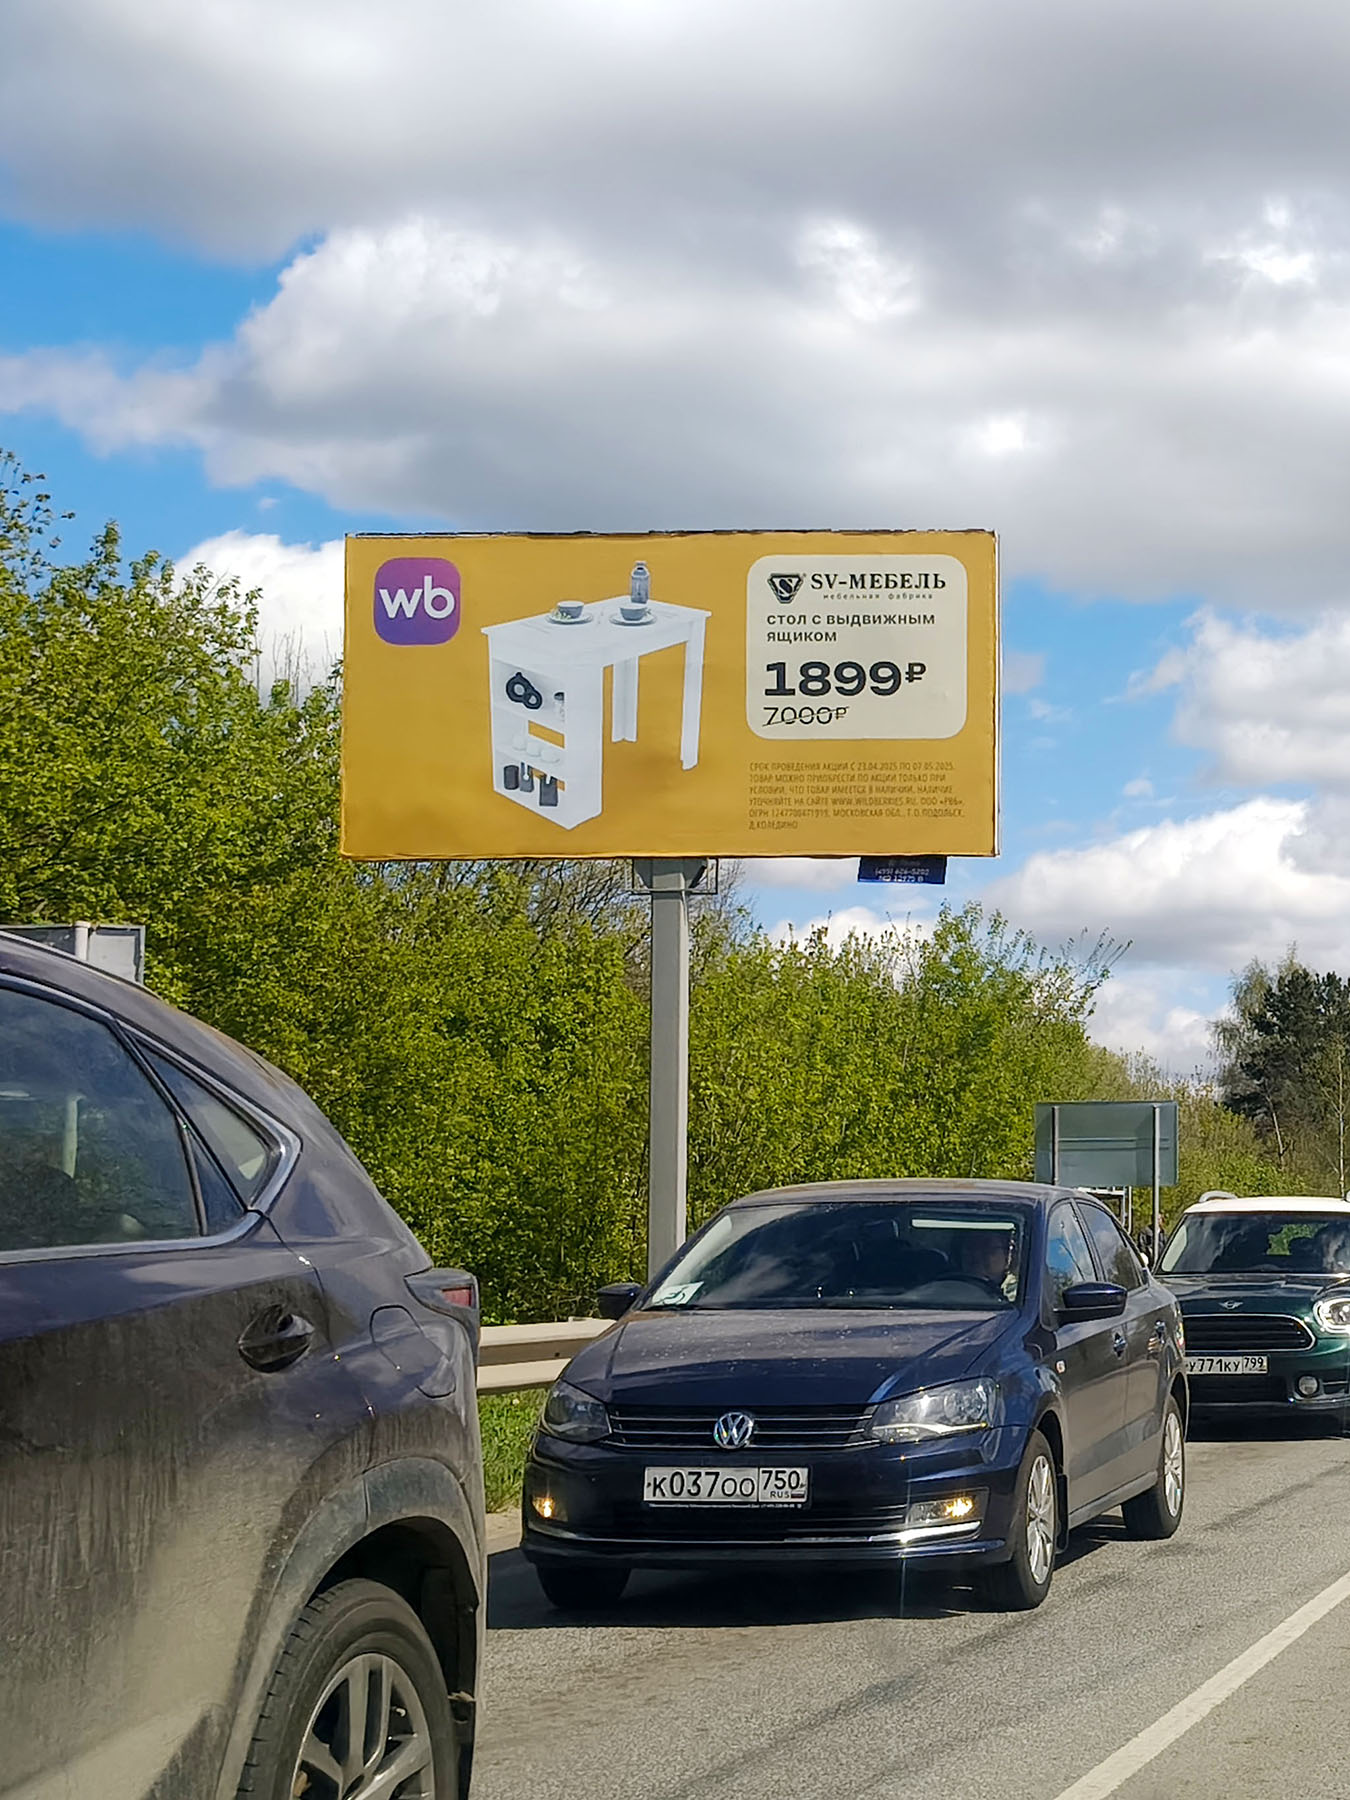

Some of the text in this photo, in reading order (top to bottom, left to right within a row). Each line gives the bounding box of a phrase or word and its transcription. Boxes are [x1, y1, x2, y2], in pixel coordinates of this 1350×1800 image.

[810, 573, 946, 590] SV-МЕБЕЛЬ
[379, 575, 455, 619] wb
[761, 1470, 801, 1490] 750
[770, 1491, 790, 1499] RUS
